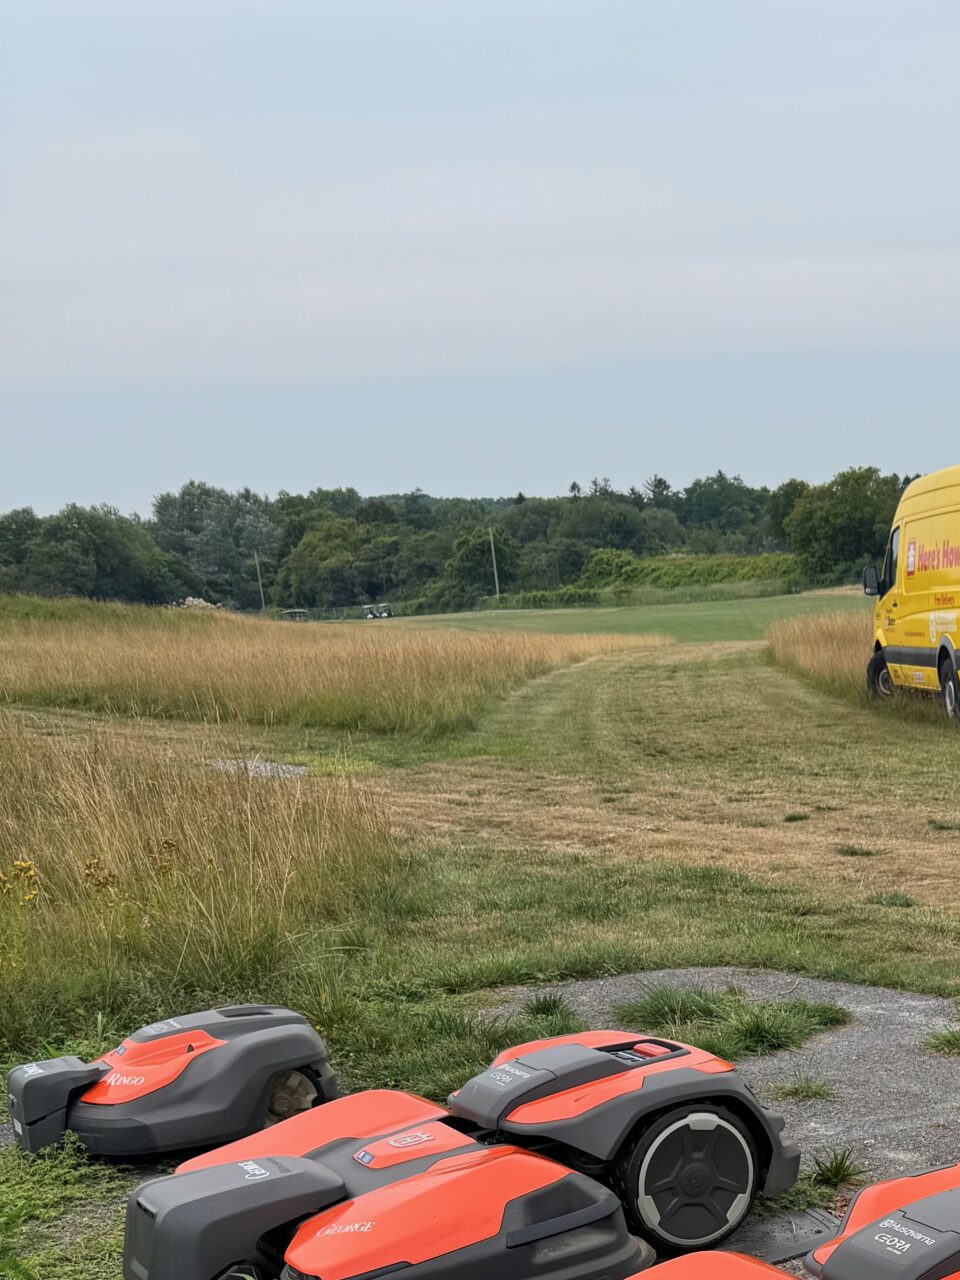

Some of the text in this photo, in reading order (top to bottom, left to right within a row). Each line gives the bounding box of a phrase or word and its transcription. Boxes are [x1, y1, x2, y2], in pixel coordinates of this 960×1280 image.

[917, 542, 940, 572] Here's
[106, 1072, 145, 1086] RINGO
[316, 1221, 376, 1237] GEORGE
[888, 1220, 936, 1246] Husqvarna
